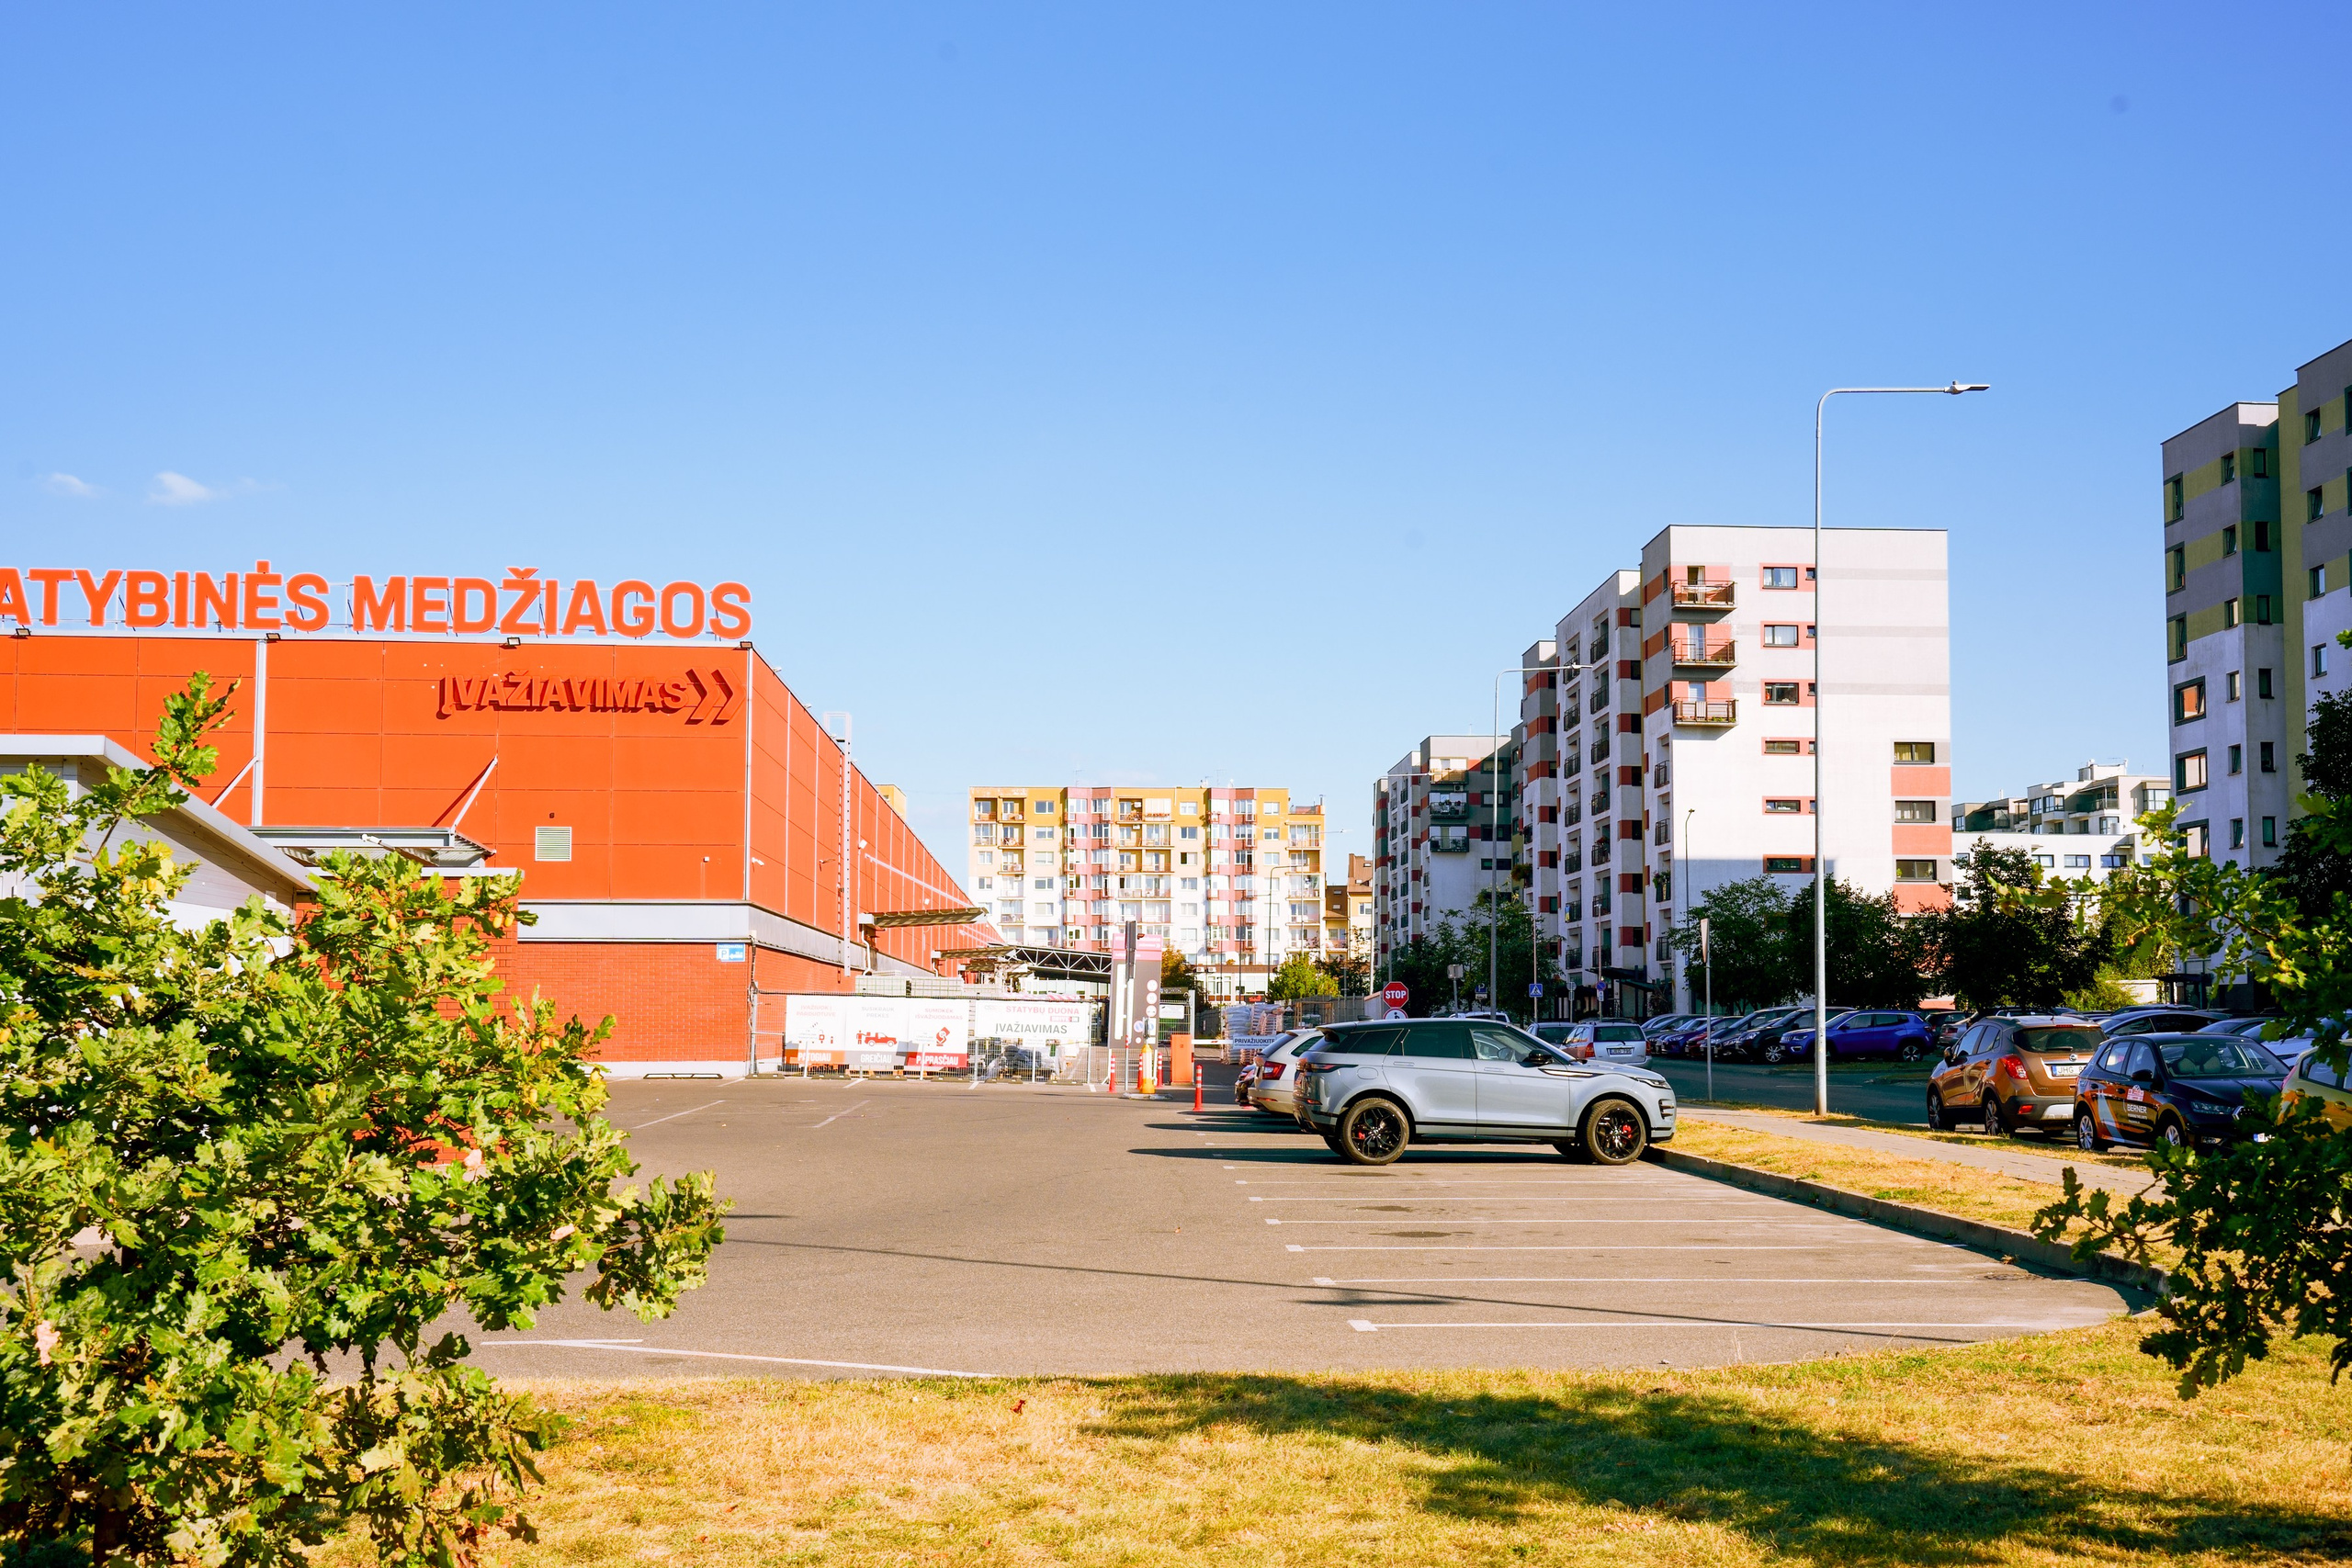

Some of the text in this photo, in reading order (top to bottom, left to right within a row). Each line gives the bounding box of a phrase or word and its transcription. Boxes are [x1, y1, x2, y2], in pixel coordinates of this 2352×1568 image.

[0, 560, 753, 640] ATYBINĖS MEDŽIAGOS
[439, 669, 691, 721] ĮVAŽIAVIMAS
[1385, 990, 1407, 999] STOP
[1006, 1006, 1046, 1014] STATYBŲ
[1048, 1007, 1080, 1015] DUONA
[995, 1021, 1068, 1034] ĮVAŽIAVIMAS
[797, 1052, 831, 1062] PATOGIAU
[861, 1053, 892, 1064] GREIČIAU
[917, 1054, 958, 1066] PAPRASČIAU
[2127, 1104, 2147, 1114] BERNER
